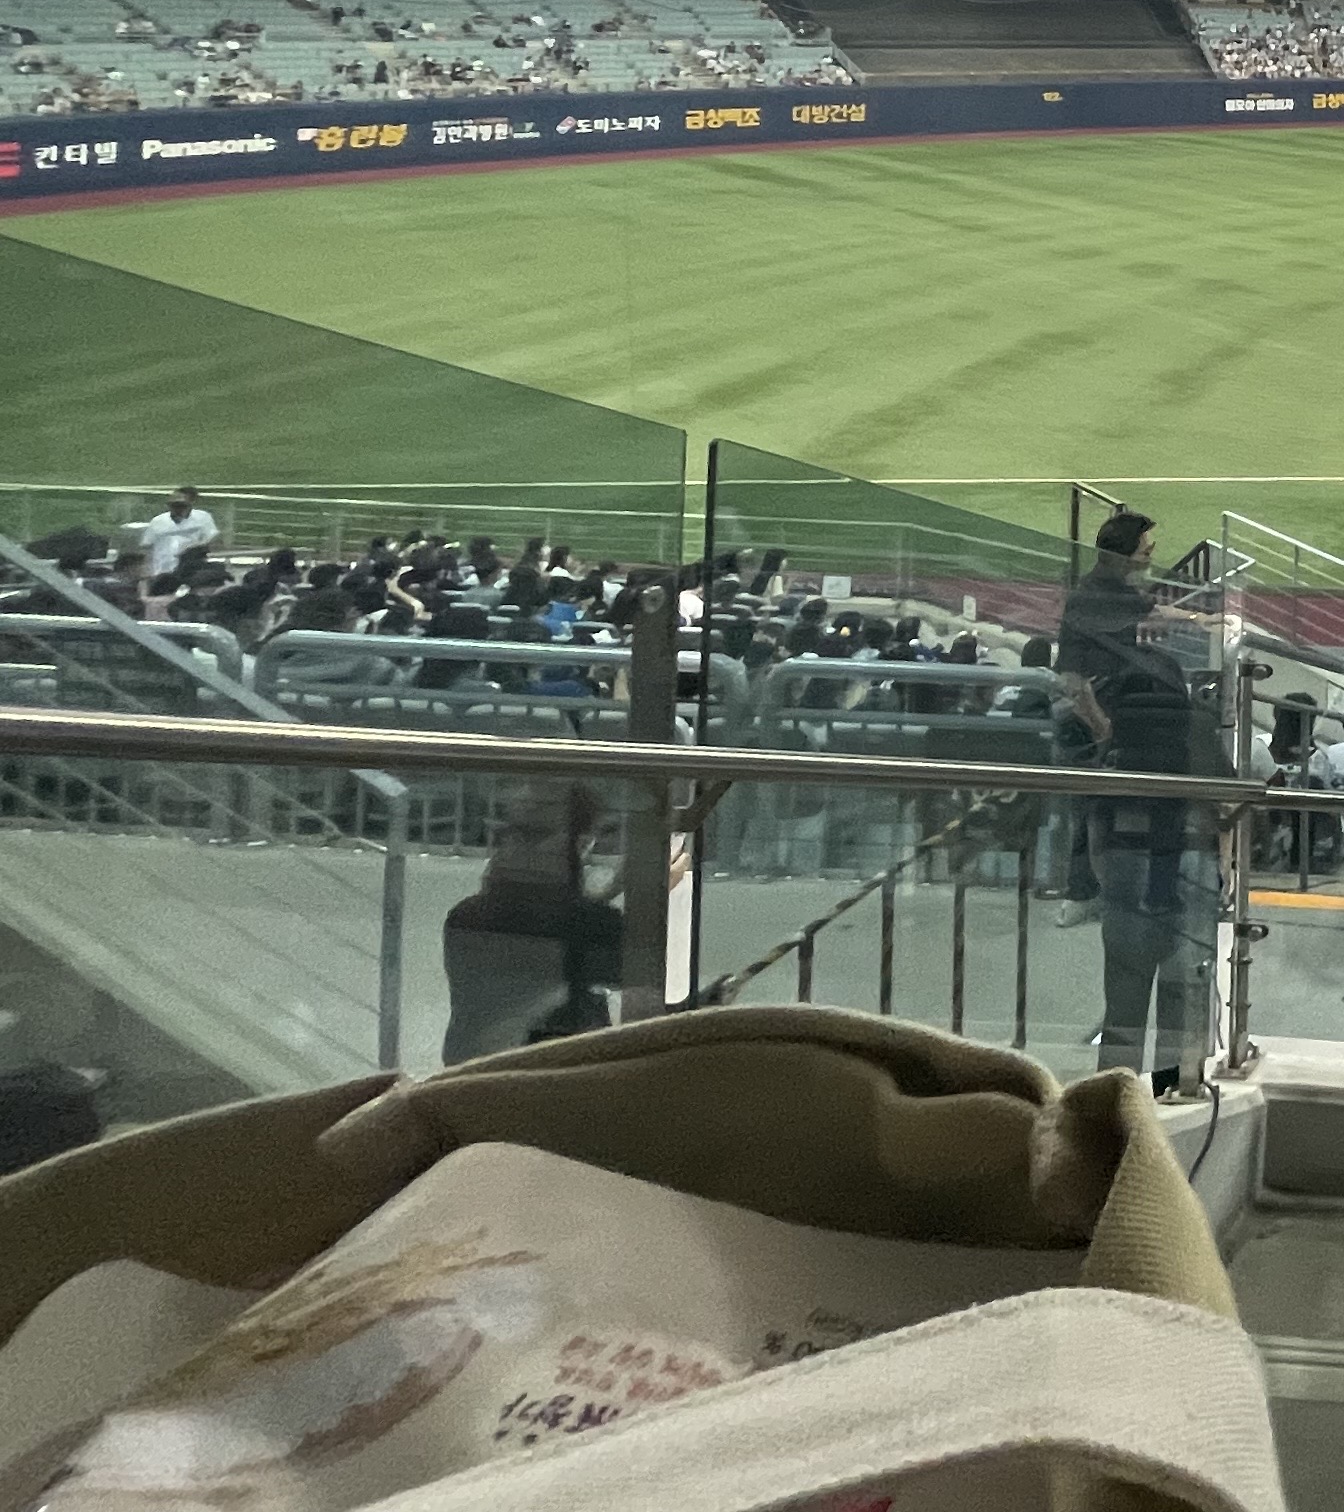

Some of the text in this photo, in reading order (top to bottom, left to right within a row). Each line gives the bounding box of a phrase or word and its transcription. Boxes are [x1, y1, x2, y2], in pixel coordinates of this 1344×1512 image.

[792, 103, 866, 124] 대방건설
[575, 116, 661, 134] 도미노피자
[142, 134, 277, 160] Panasonic
